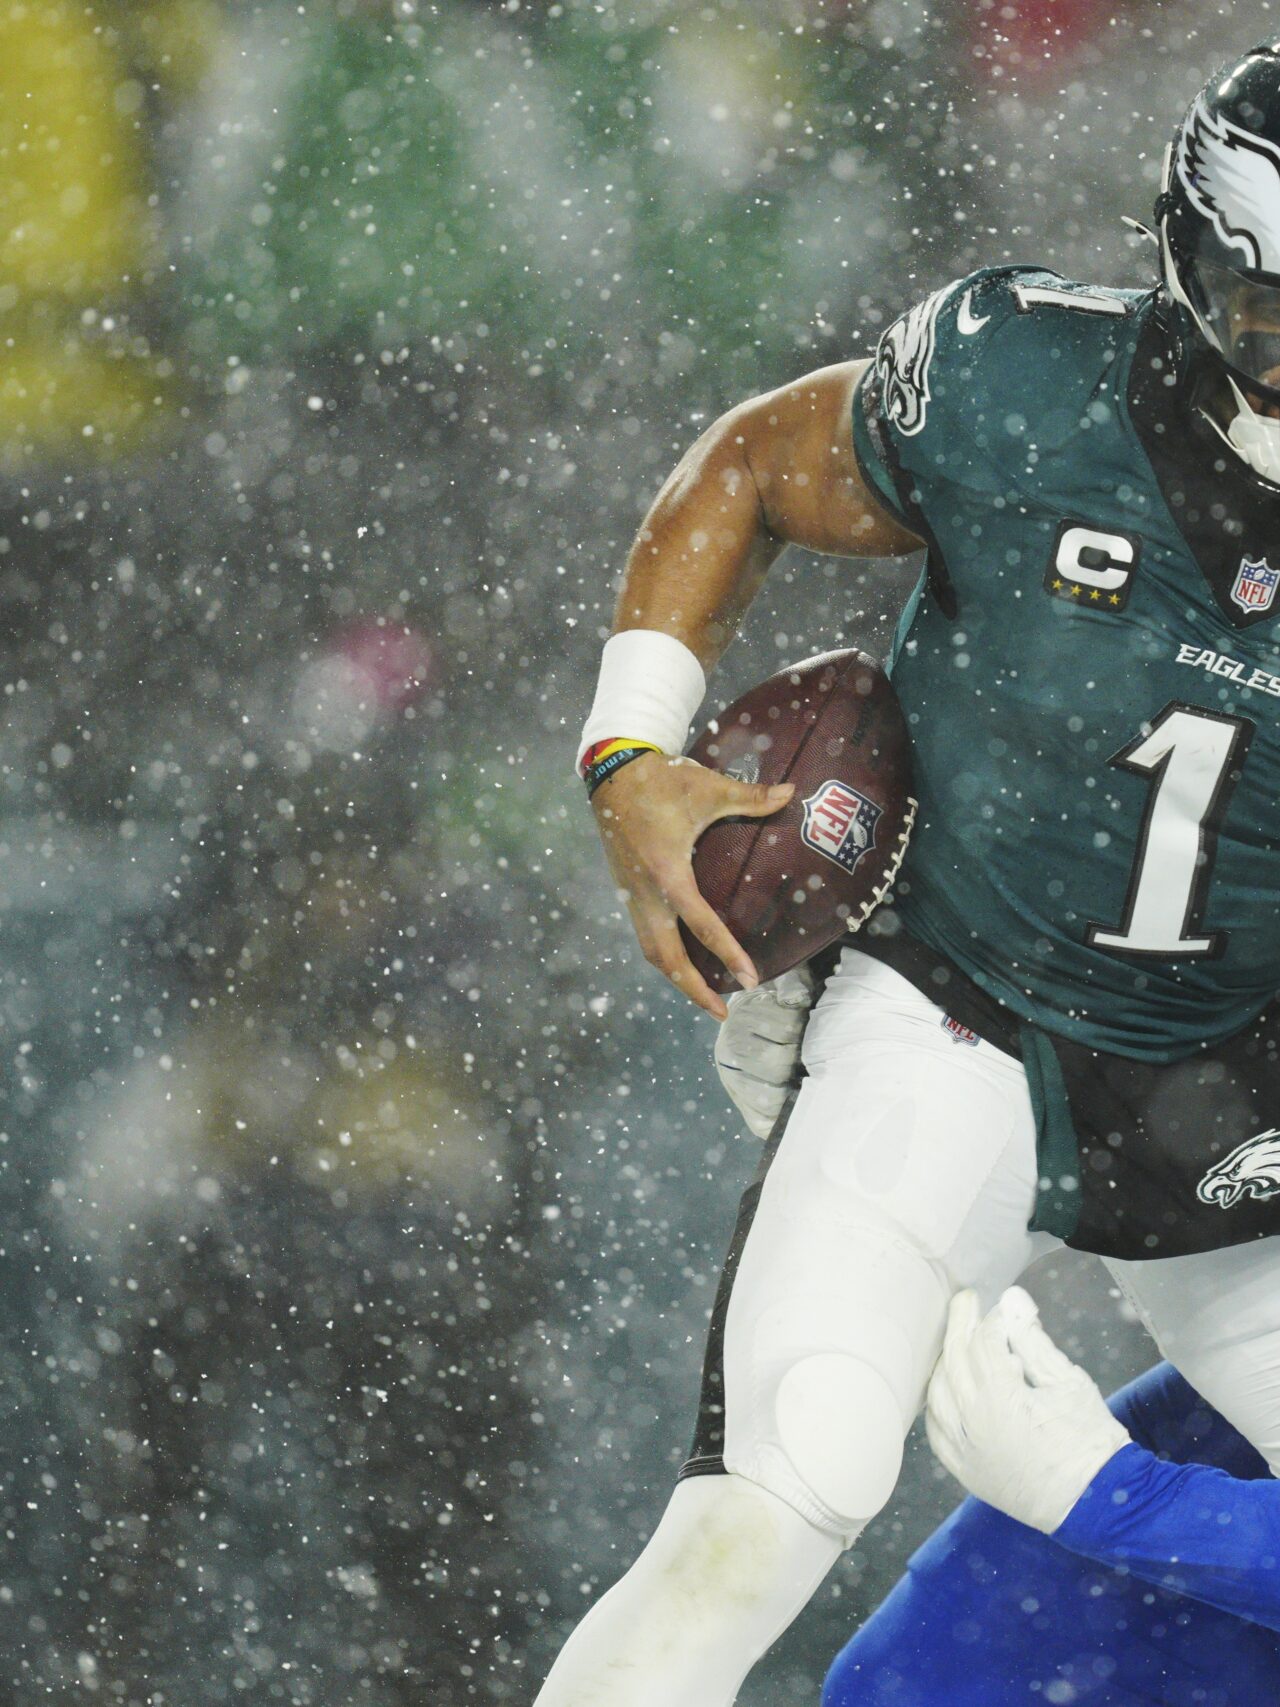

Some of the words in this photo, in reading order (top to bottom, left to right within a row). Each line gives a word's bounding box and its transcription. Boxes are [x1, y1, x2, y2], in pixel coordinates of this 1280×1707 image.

[1056, 527, 1134, 590] C
[1237, 579, 1267, 605] NFL
[594, 748, 634, 779] Armor
[809, 787, 860, 847] NFL
[1088, 704, 1246, 955] 1
[946, 1018, 977, 1041] NFL
